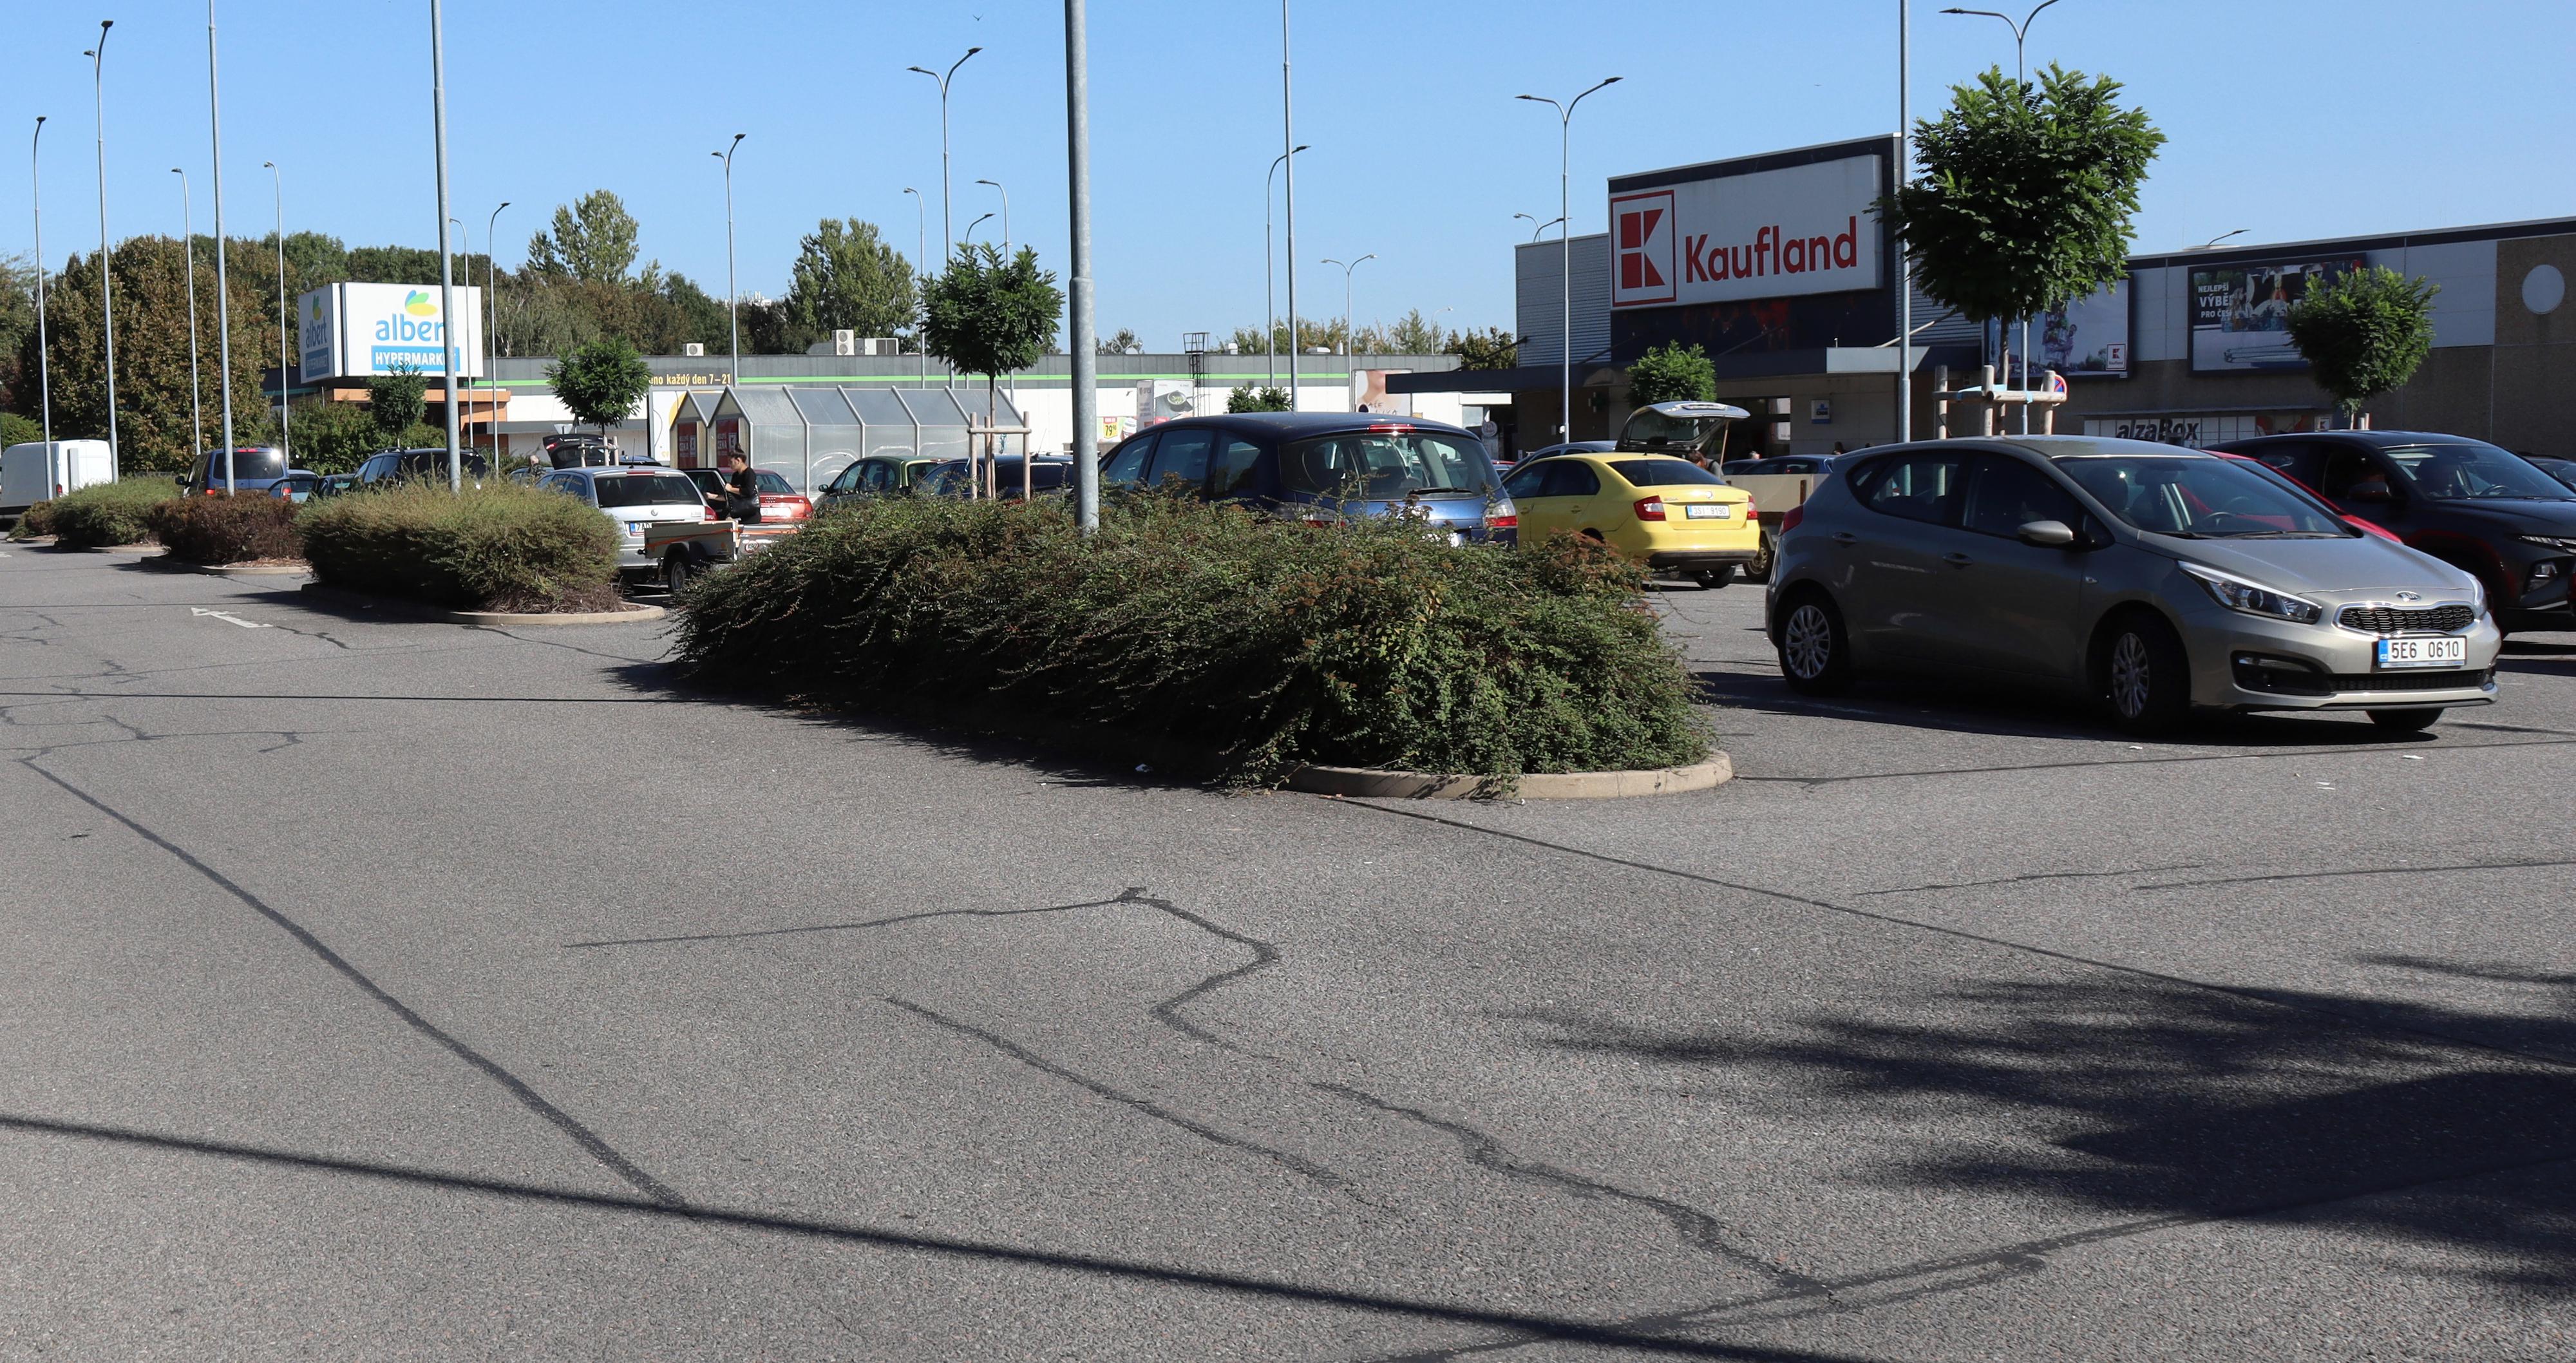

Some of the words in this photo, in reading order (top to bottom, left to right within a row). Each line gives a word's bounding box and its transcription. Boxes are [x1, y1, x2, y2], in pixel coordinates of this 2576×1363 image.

[1685, 216, 1857, 283] Kaufland
[2198, 282, 2229, 293] NEJLEPŠÍ
[306, 316, 327, 348] albert
[375, 314, 444, 341] alber
[375, 352, 456, 366] HYPERMARK
[667, 374, 690, 386] každý
[692, 375, 707, 384] den
[1105, 425, 1112, 436] 79
[1710, 506, 1727, 515] 9190
[2391, 642, 2417, 658] 5E6
[2428, 641, 2459, 658] 0610
